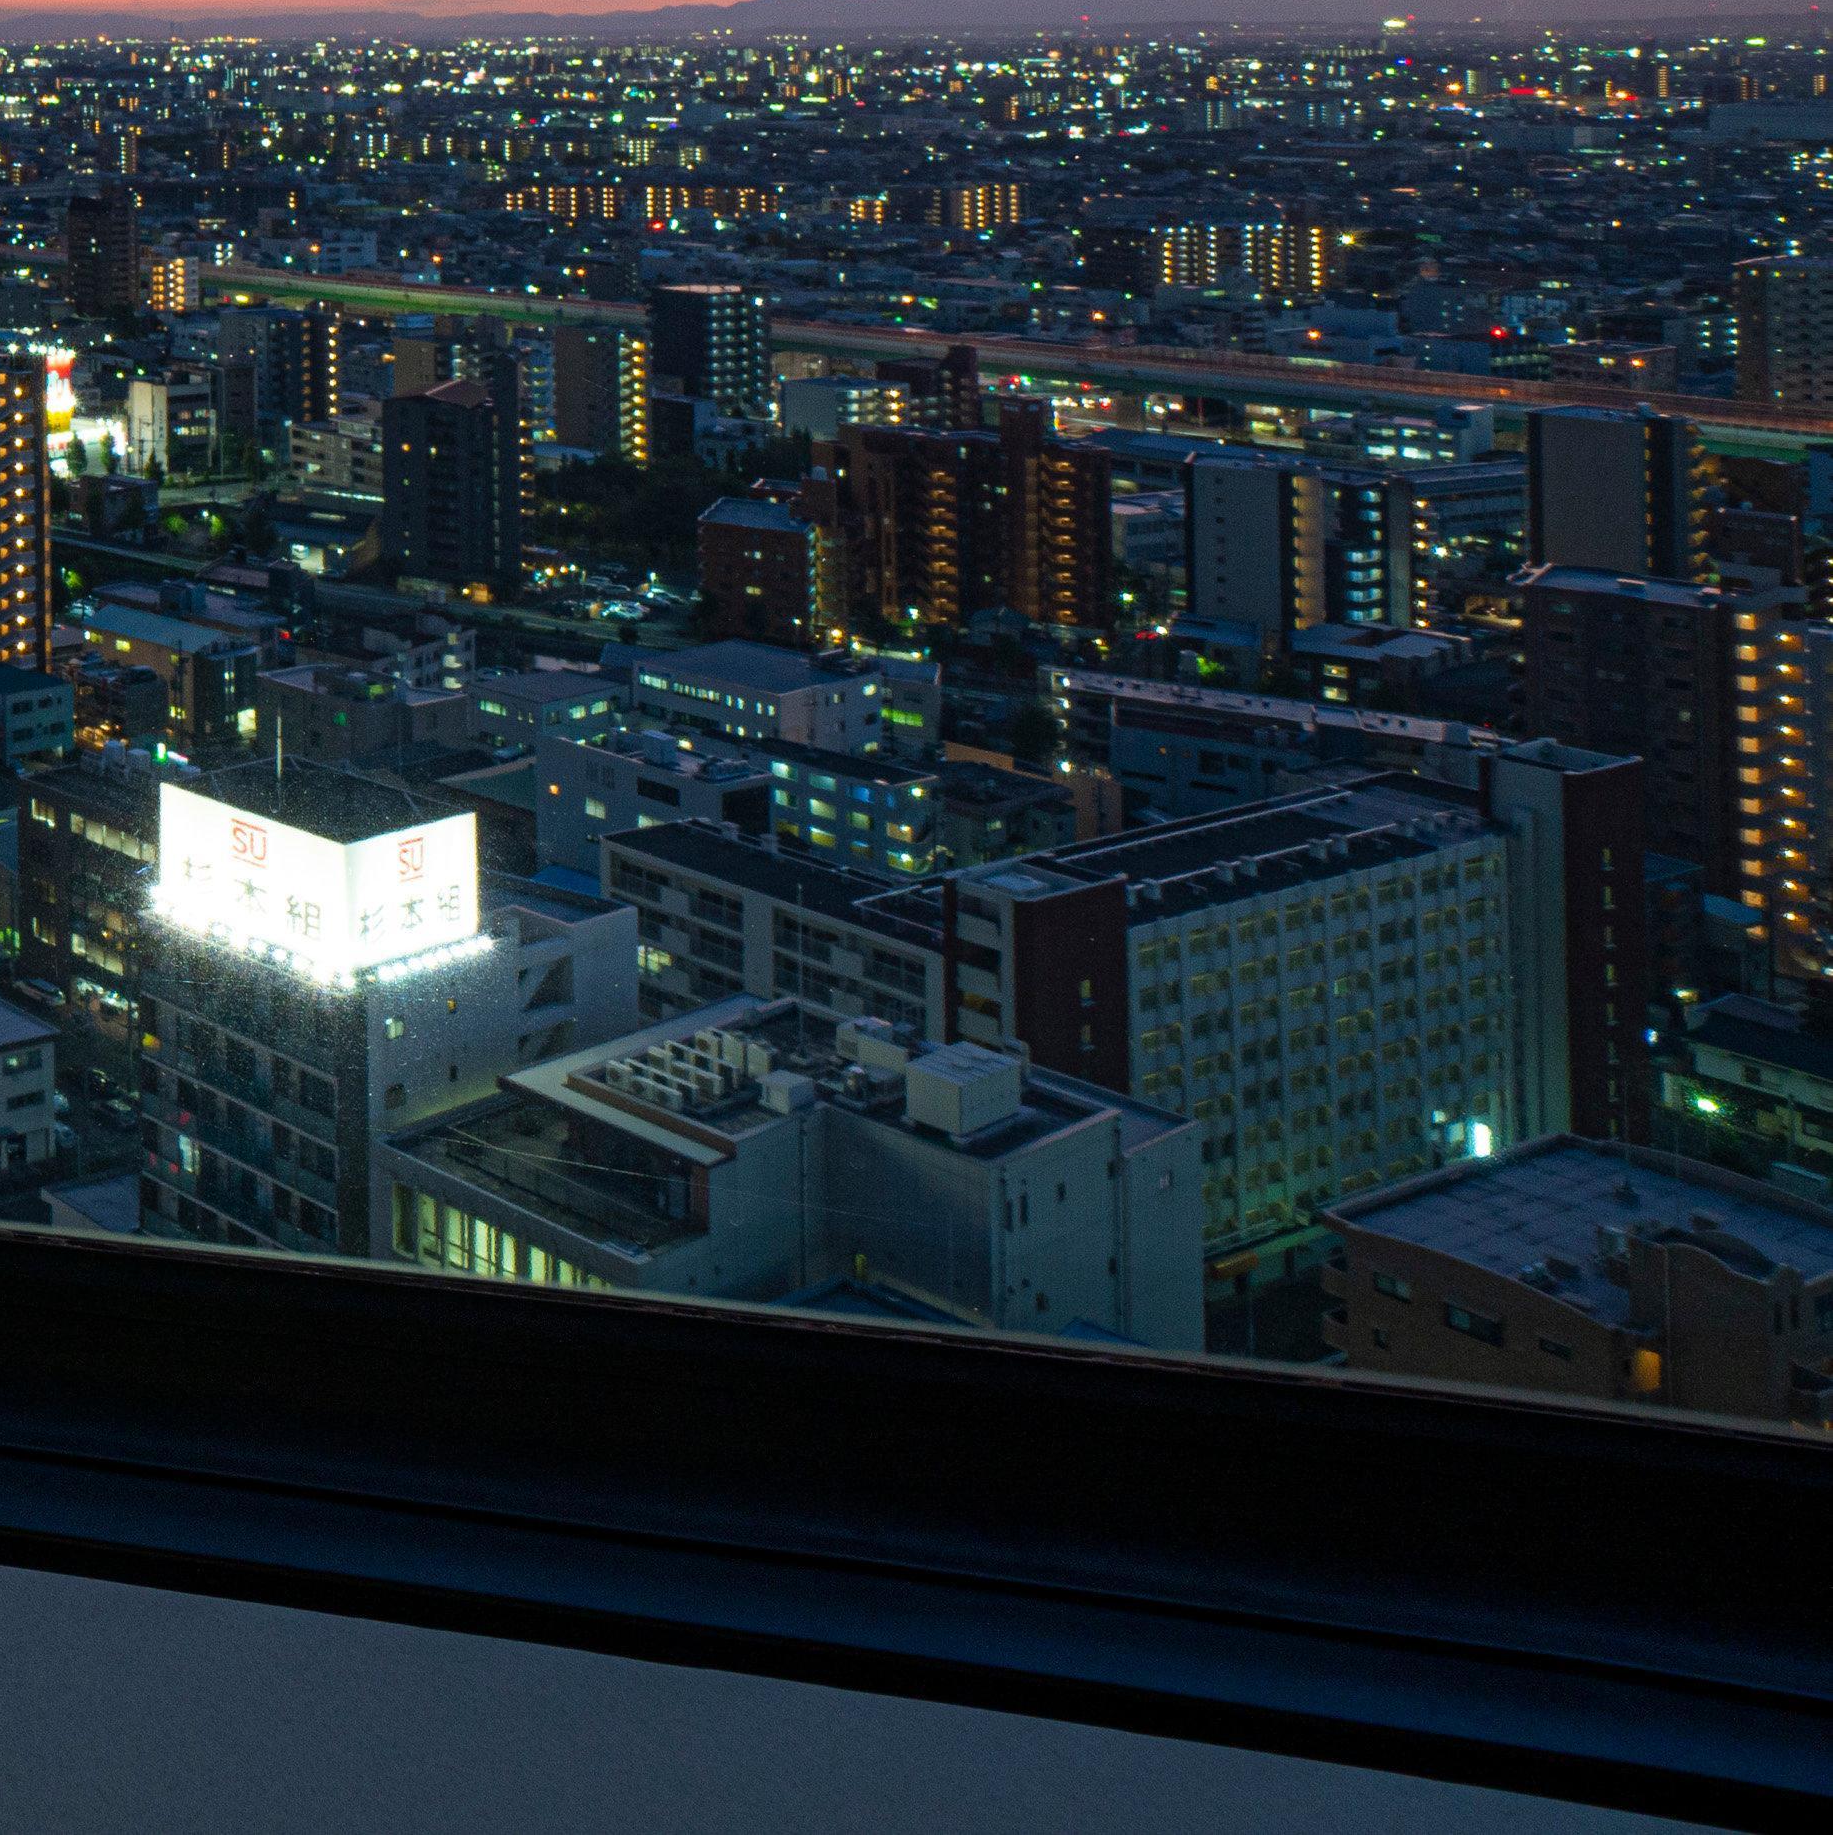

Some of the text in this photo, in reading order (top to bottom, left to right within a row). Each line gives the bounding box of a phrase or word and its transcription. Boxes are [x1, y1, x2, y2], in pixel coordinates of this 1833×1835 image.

[232, 826, 268, 862] SU
[399, 844, 424, 875] SU
[359, 884, 461, 944] 杉本組
